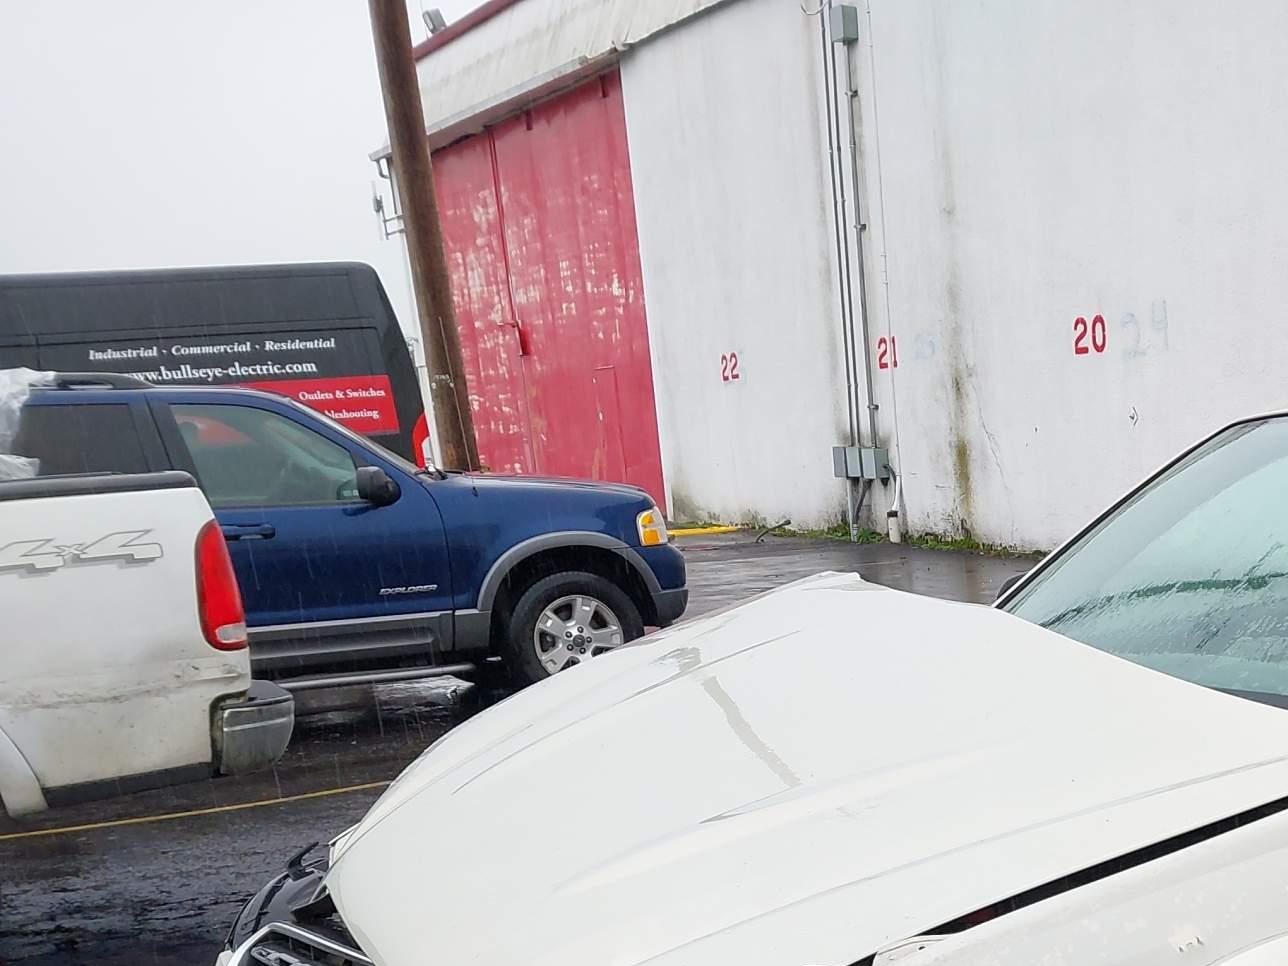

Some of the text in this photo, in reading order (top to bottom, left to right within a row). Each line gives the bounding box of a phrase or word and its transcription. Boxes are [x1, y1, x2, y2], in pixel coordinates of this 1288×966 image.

[1073, 314, 1106, 355] 20
[88, 337, 336, 360] Industrial Commercial Residential
[876, 335, 899, 370] 21
[128, 361, 317, 382] ww.bullseye-electric.com
[720, 352, 740, 382] 22
[299, 387, 386, 401] Outlets & Switches
[379, 584, 438, 596] EXPLORER
